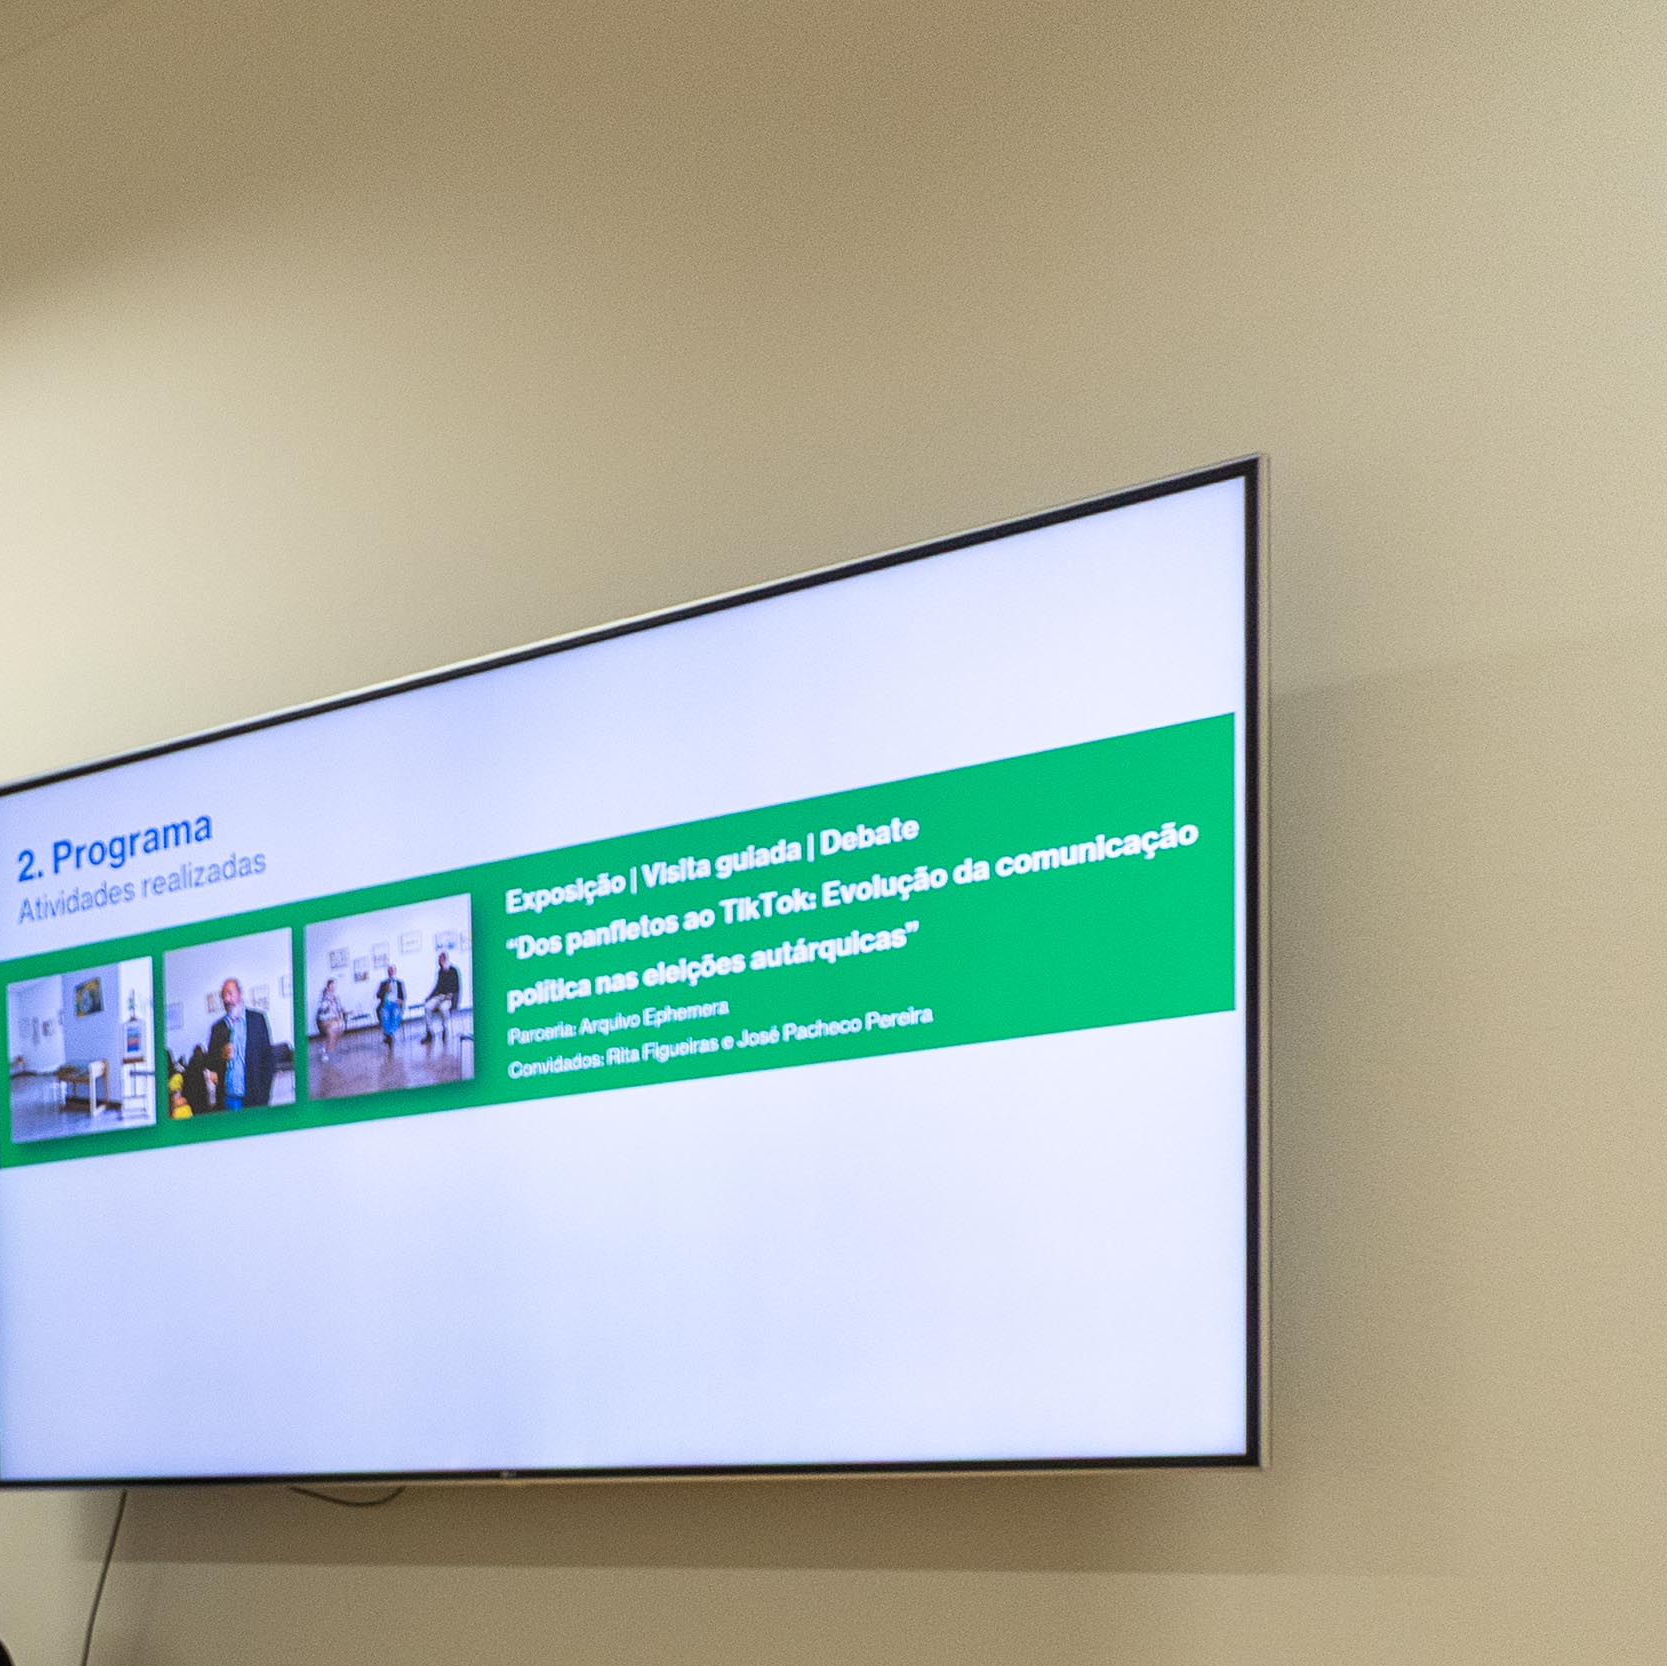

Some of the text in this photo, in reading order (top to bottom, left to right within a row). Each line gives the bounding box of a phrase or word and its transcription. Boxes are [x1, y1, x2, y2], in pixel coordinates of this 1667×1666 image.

[17, 815, 213, 882] 2. Programa
[505, 873, 627, 914] Exposição
[641, 857, 711, 888] Visita
[715, 839, 802, 879] guiada
[820, 817, 920, 856] Debate
[19, 851, 267, 924] Atividades realizadas
[566, 913, 679, 955] panfletos
[682, 909, 716, 931] ao
[719, 888, 817, 924] TikTok:
[822, 866, 948, 908] Evolução
[952, 858, 990, 884] da
[995, 822, 1199, 877] comunicação
[595, 971, 639, 995] nas
[642, 953, 746, 987] eleições
[508, 1001, 730, 1046] Parceria: Arquivo Ephemera
[508, 1006, 934, 1079] Convidados: Rita Figueiras e José Pacheco Pereira
